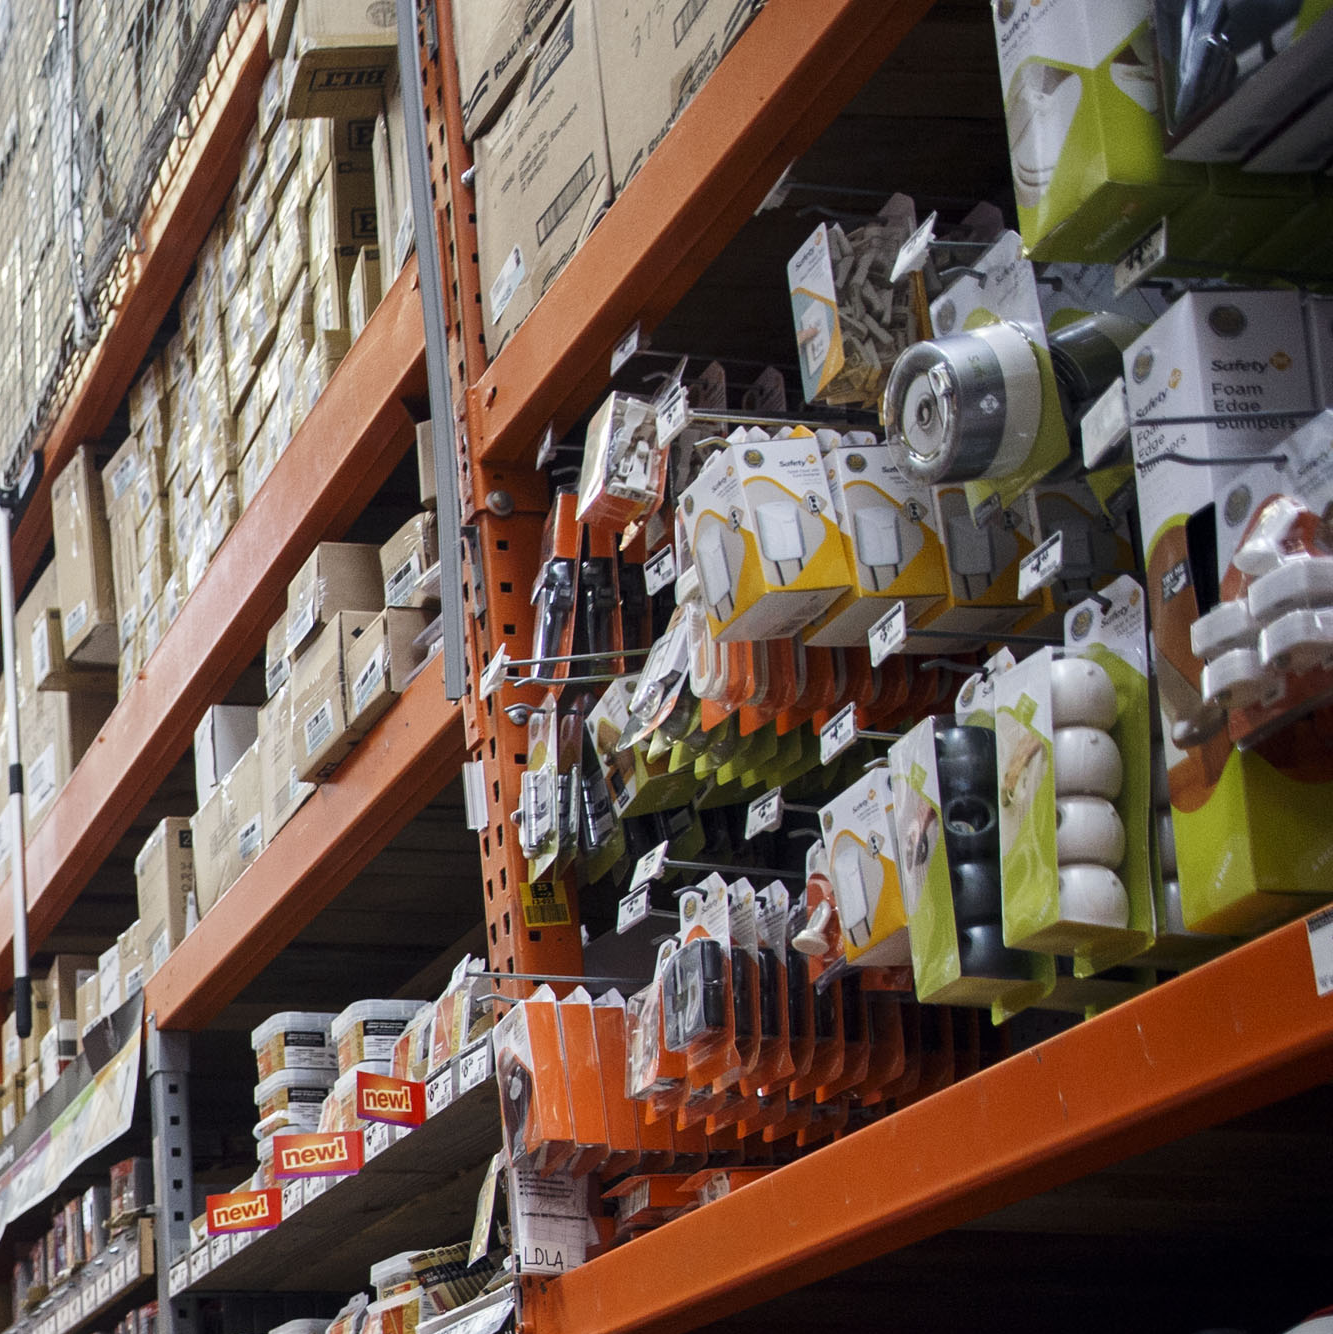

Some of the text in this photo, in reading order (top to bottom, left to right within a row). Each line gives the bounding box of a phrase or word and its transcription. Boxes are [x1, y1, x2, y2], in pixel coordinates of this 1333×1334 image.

[1211, 360, 1269, 374] Safety
[1212, 383, 1264, 396] Foam
[1213, 401, 1262, 415] Edge
[364, 1087, 411, 1111] new!
[284, 1138, 347, 1168] new!
[215, 1196, 268, 1226] new!
